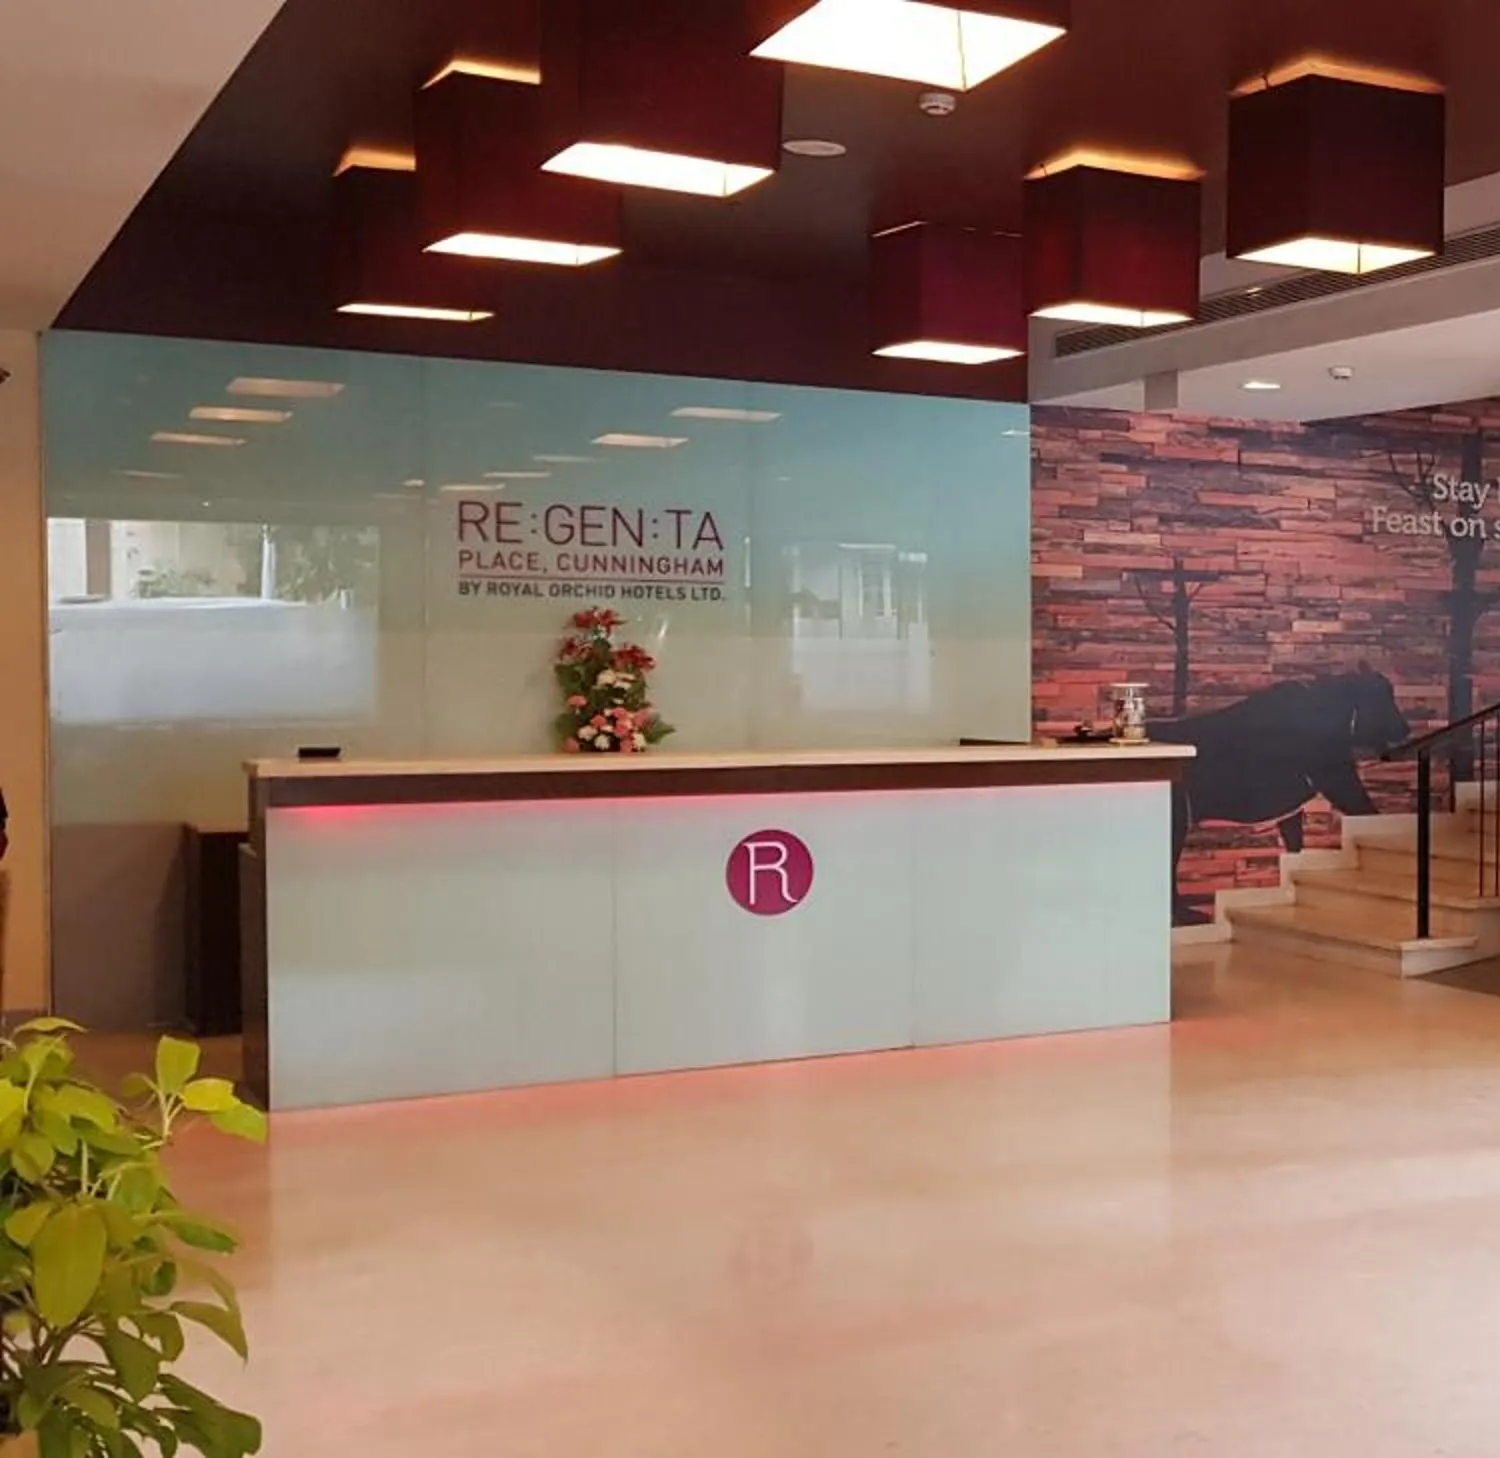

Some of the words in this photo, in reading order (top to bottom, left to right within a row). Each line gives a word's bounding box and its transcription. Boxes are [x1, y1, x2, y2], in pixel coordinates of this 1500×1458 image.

[1432, 473, 1490, 509] Stay
[457, 500, 724, 551] RE:GEN:TA
[1373, 506, 1443, 536] Feast
[1450, 516, 1486, 538] on
[458, 550, 548, 573] PLACE,
[556, 553, 724, 576] CUNNINGHAM
[458, 581, 480, 596] BY
[487, 582, 543, 598] ROYAL
[548, 583, 616, 599] ORCHID
[621, 585, 686, 600] HOTELS
[691, 586, 726, 601] LTD.
[743, 841, 798, 905] R
